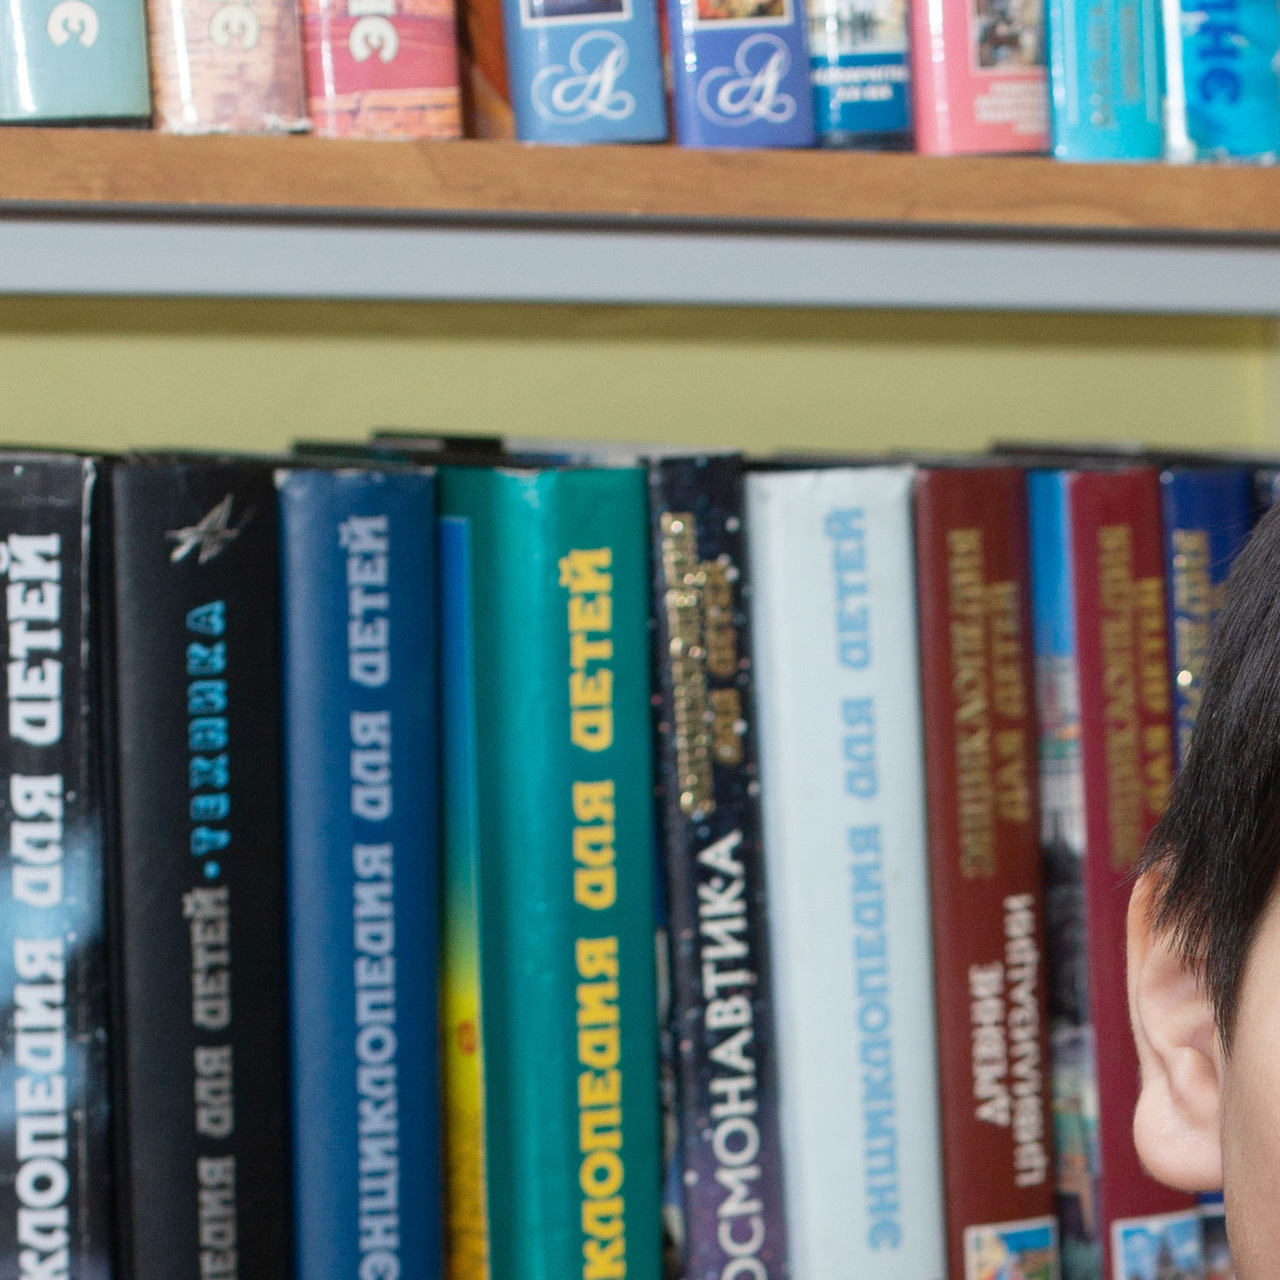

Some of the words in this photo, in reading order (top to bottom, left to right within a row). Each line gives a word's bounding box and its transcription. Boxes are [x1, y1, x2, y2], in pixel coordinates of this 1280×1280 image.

[2, 531, 62, 745] ДЕТЕЙ
[341, 511, 392, 688] ДЕТЕЙ
[558, 547, 613, 753] ДЕТЕЙ
[825, 505, 875, 672] ДЕТЕЙ
[185, 599, 229, 856] ТЕХНИКА
[350, 709, 395, 822] ДЛЯ
[842, 693, 878, 800] ДЛЯ
[946, 526, 997, 878] ЭНЦИКЛОПЕДИЯ
[10, 773, 64, 909] ДЛЯ
[571, 778, 617, 911] ДЛЯ
[184, 886, 231, 1031] ДЕТЕЙ
[848, 824, 905, 1250] ЭНЦИКЛОПЕДИЯ
[1002, 893, 1046, 1188] ЦИВИЛИЗАЦИИ
[194, 1044, 234, 1139] ДЛЯ
[968, 961, 1010, 1127] ДРЕВНИЕ
